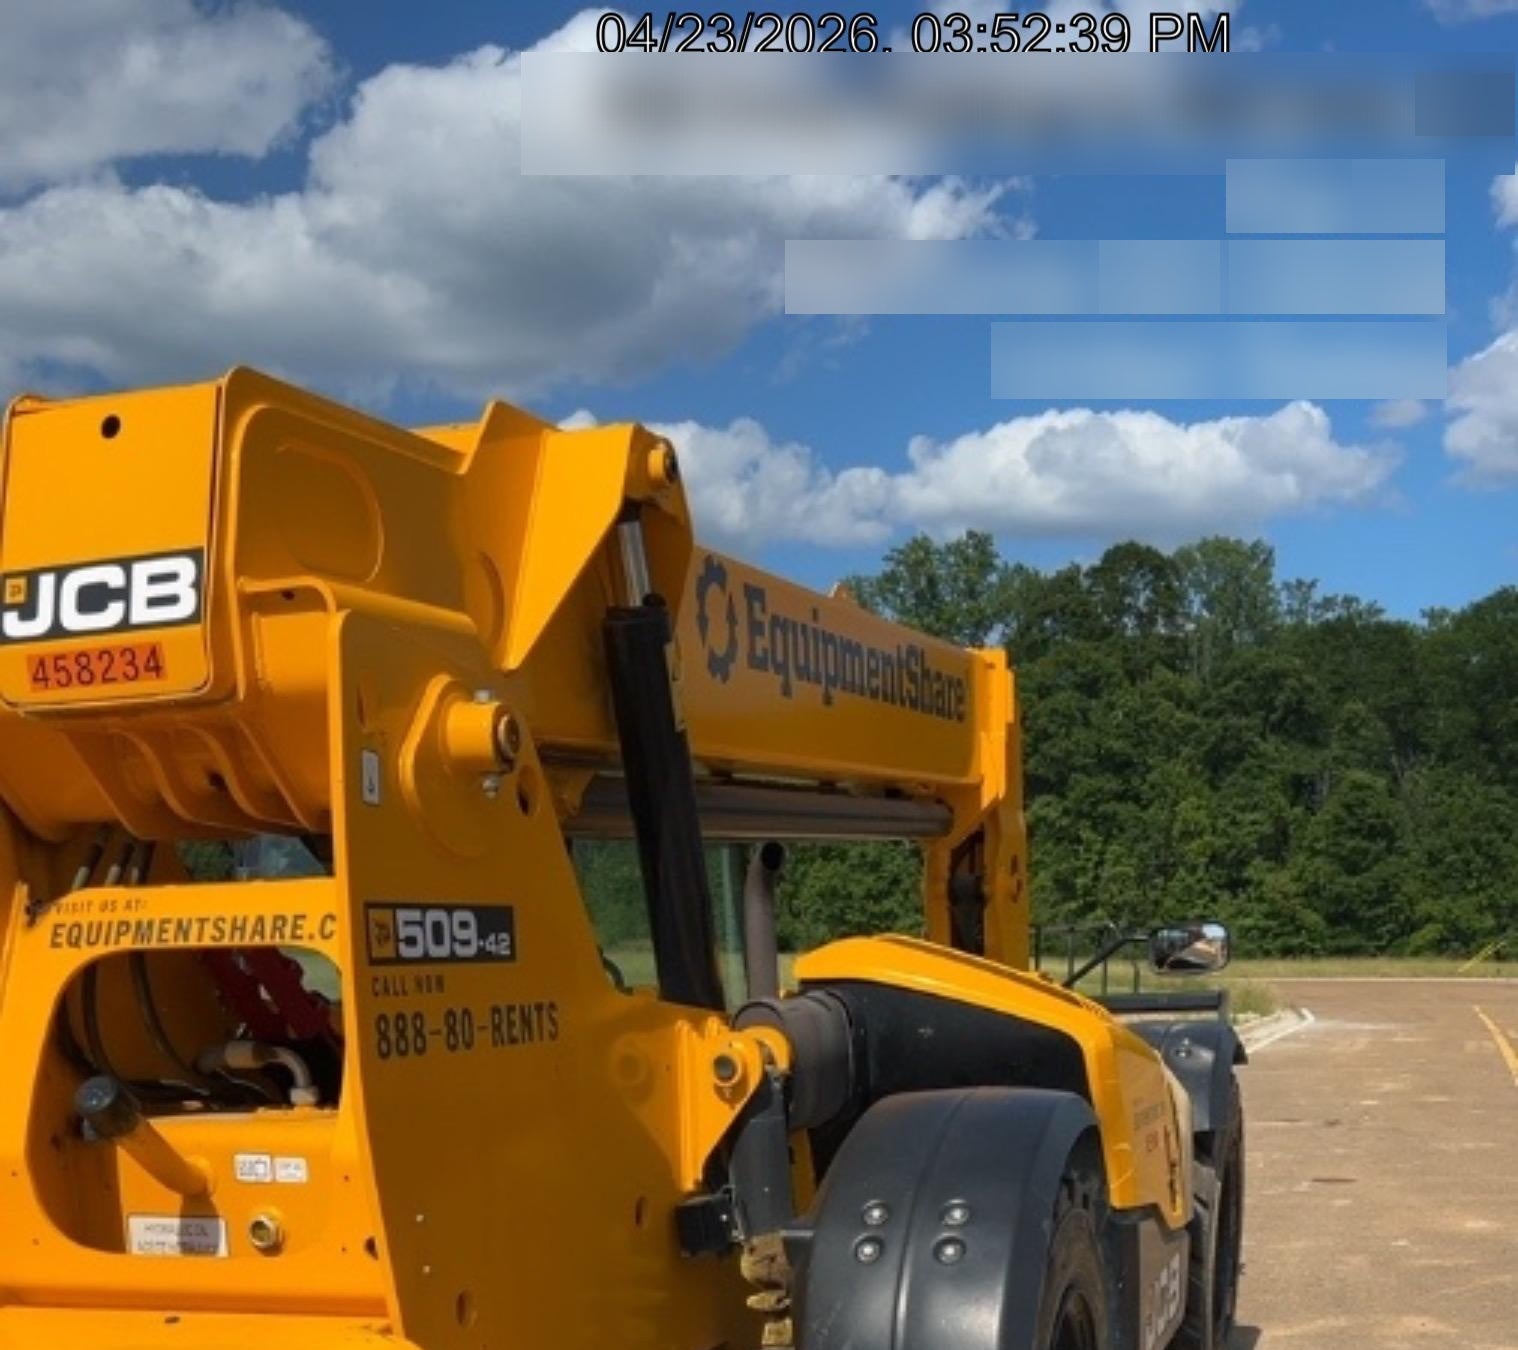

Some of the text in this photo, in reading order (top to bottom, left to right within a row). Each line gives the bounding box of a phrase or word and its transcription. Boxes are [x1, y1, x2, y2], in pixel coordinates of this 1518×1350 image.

[2, 555, 197, 638] JCB
[31, 645, 164, 689] 458234
[743, 583, 966, 722] EquipmentShare
[99, 899, 118, 912] US
[371, 975, 409, 997] CALL
[375, 1001, 560, 1060] 888-80-RENTS
